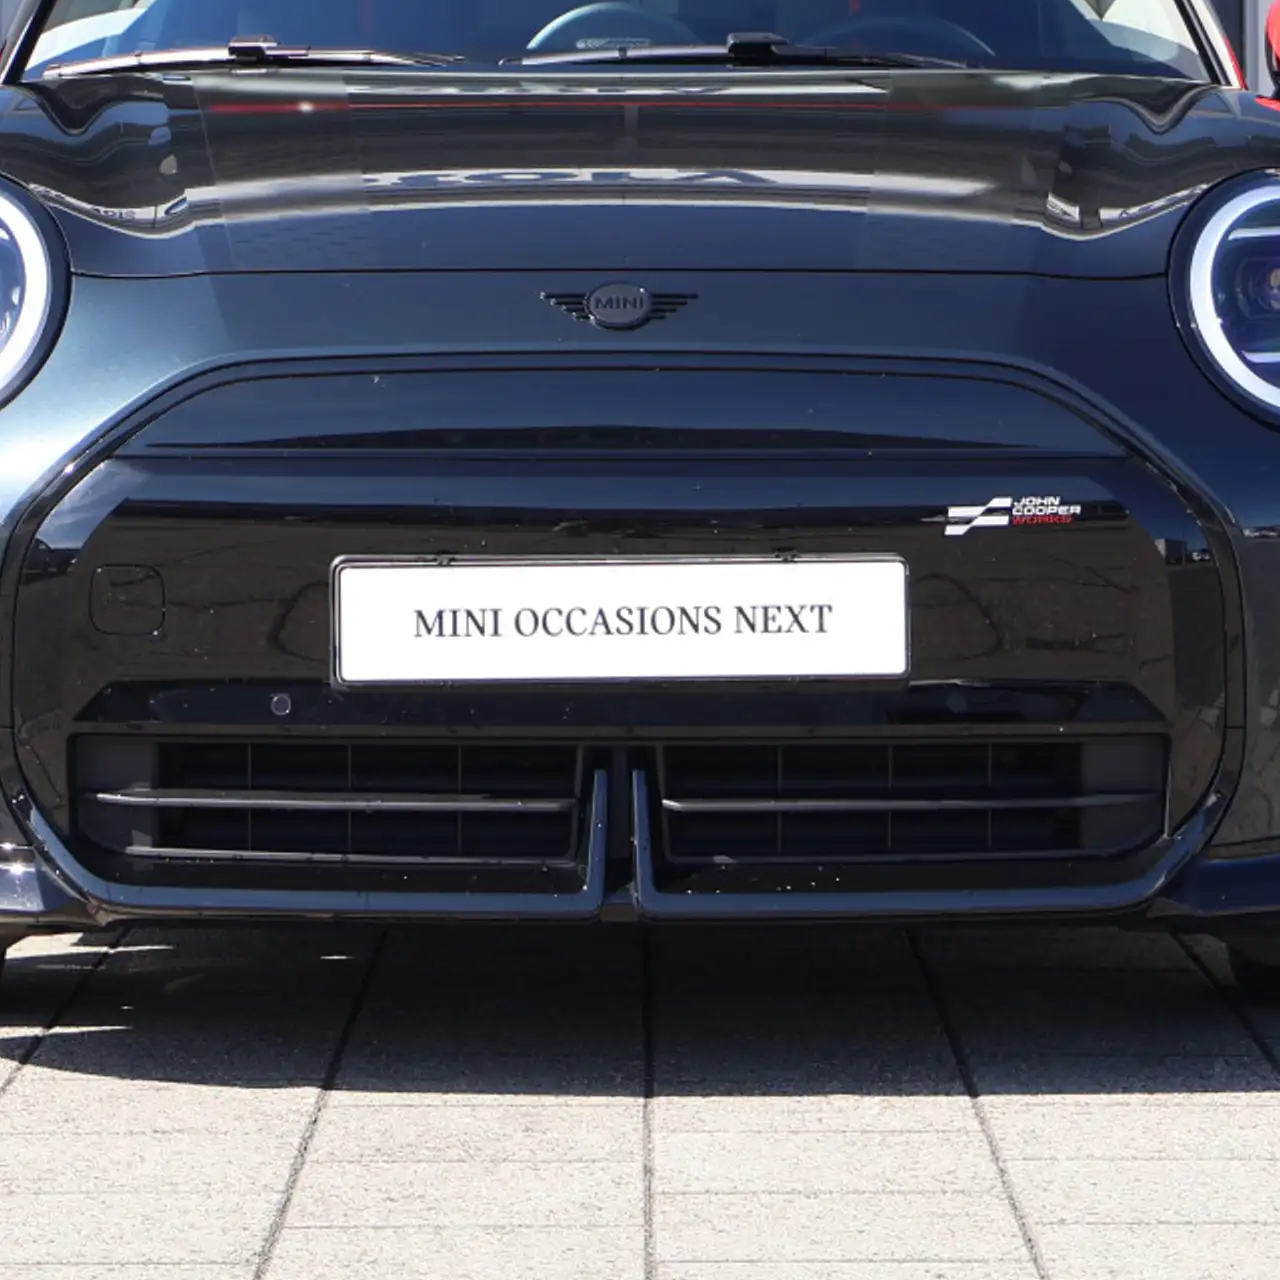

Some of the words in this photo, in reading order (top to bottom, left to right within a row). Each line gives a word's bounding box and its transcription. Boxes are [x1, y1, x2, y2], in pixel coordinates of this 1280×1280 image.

[595, 296, 644, 310] MINI
[1014, 496, 1060, 505] JOHN
[1012, 505, 1081, 515] COOPER
[1012, 514, 1074, 525] WORKS
[413, 608, 502, 638] MINI
[515, 607, 721, 636] OCCASIONS
[736, 605, 832, 633] NEXT
